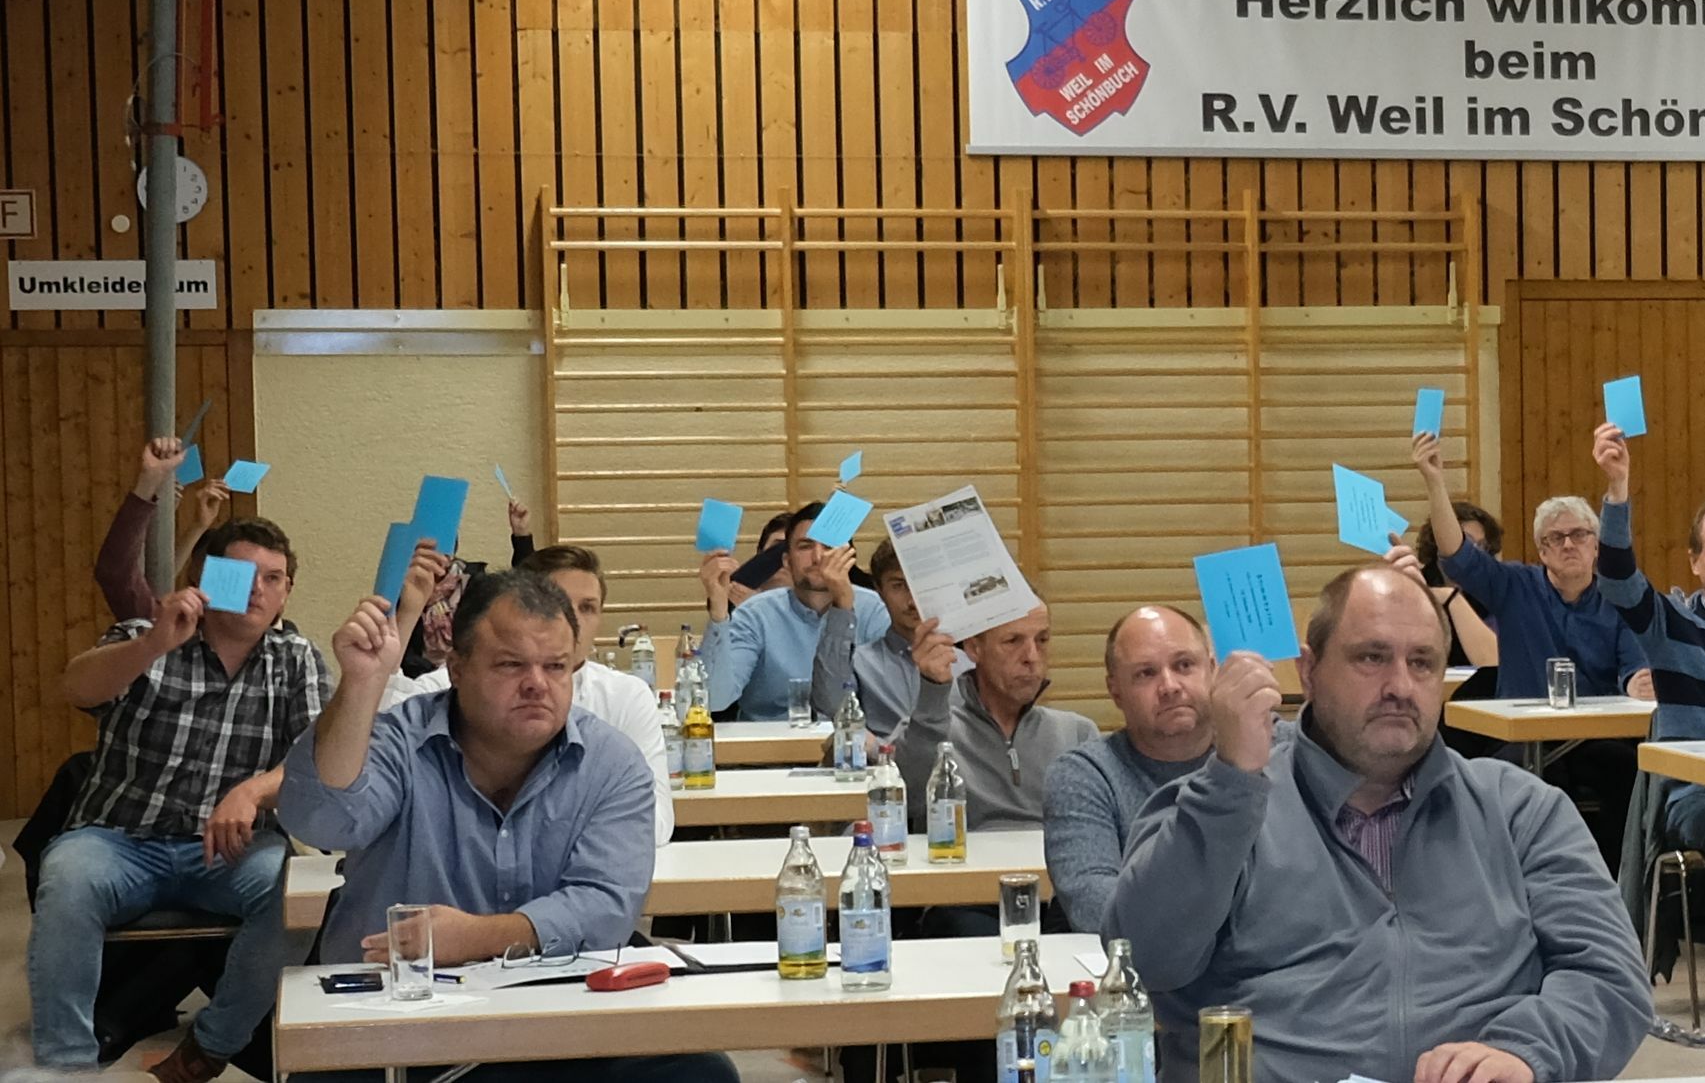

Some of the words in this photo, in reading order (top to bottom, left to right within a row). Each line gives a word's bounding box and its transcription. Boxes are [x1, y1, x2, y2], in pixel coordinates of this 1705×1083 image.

[1059, 73, 1094, 103] WEIL
[1094, 53, 1114, 74] IM
[1464, 39, 1596, 80] beim
[1201, 92, 1307, 133] R.V.
[1326, 94, 1444, 135] Weil
[1467, 96, 1530, 136] im
